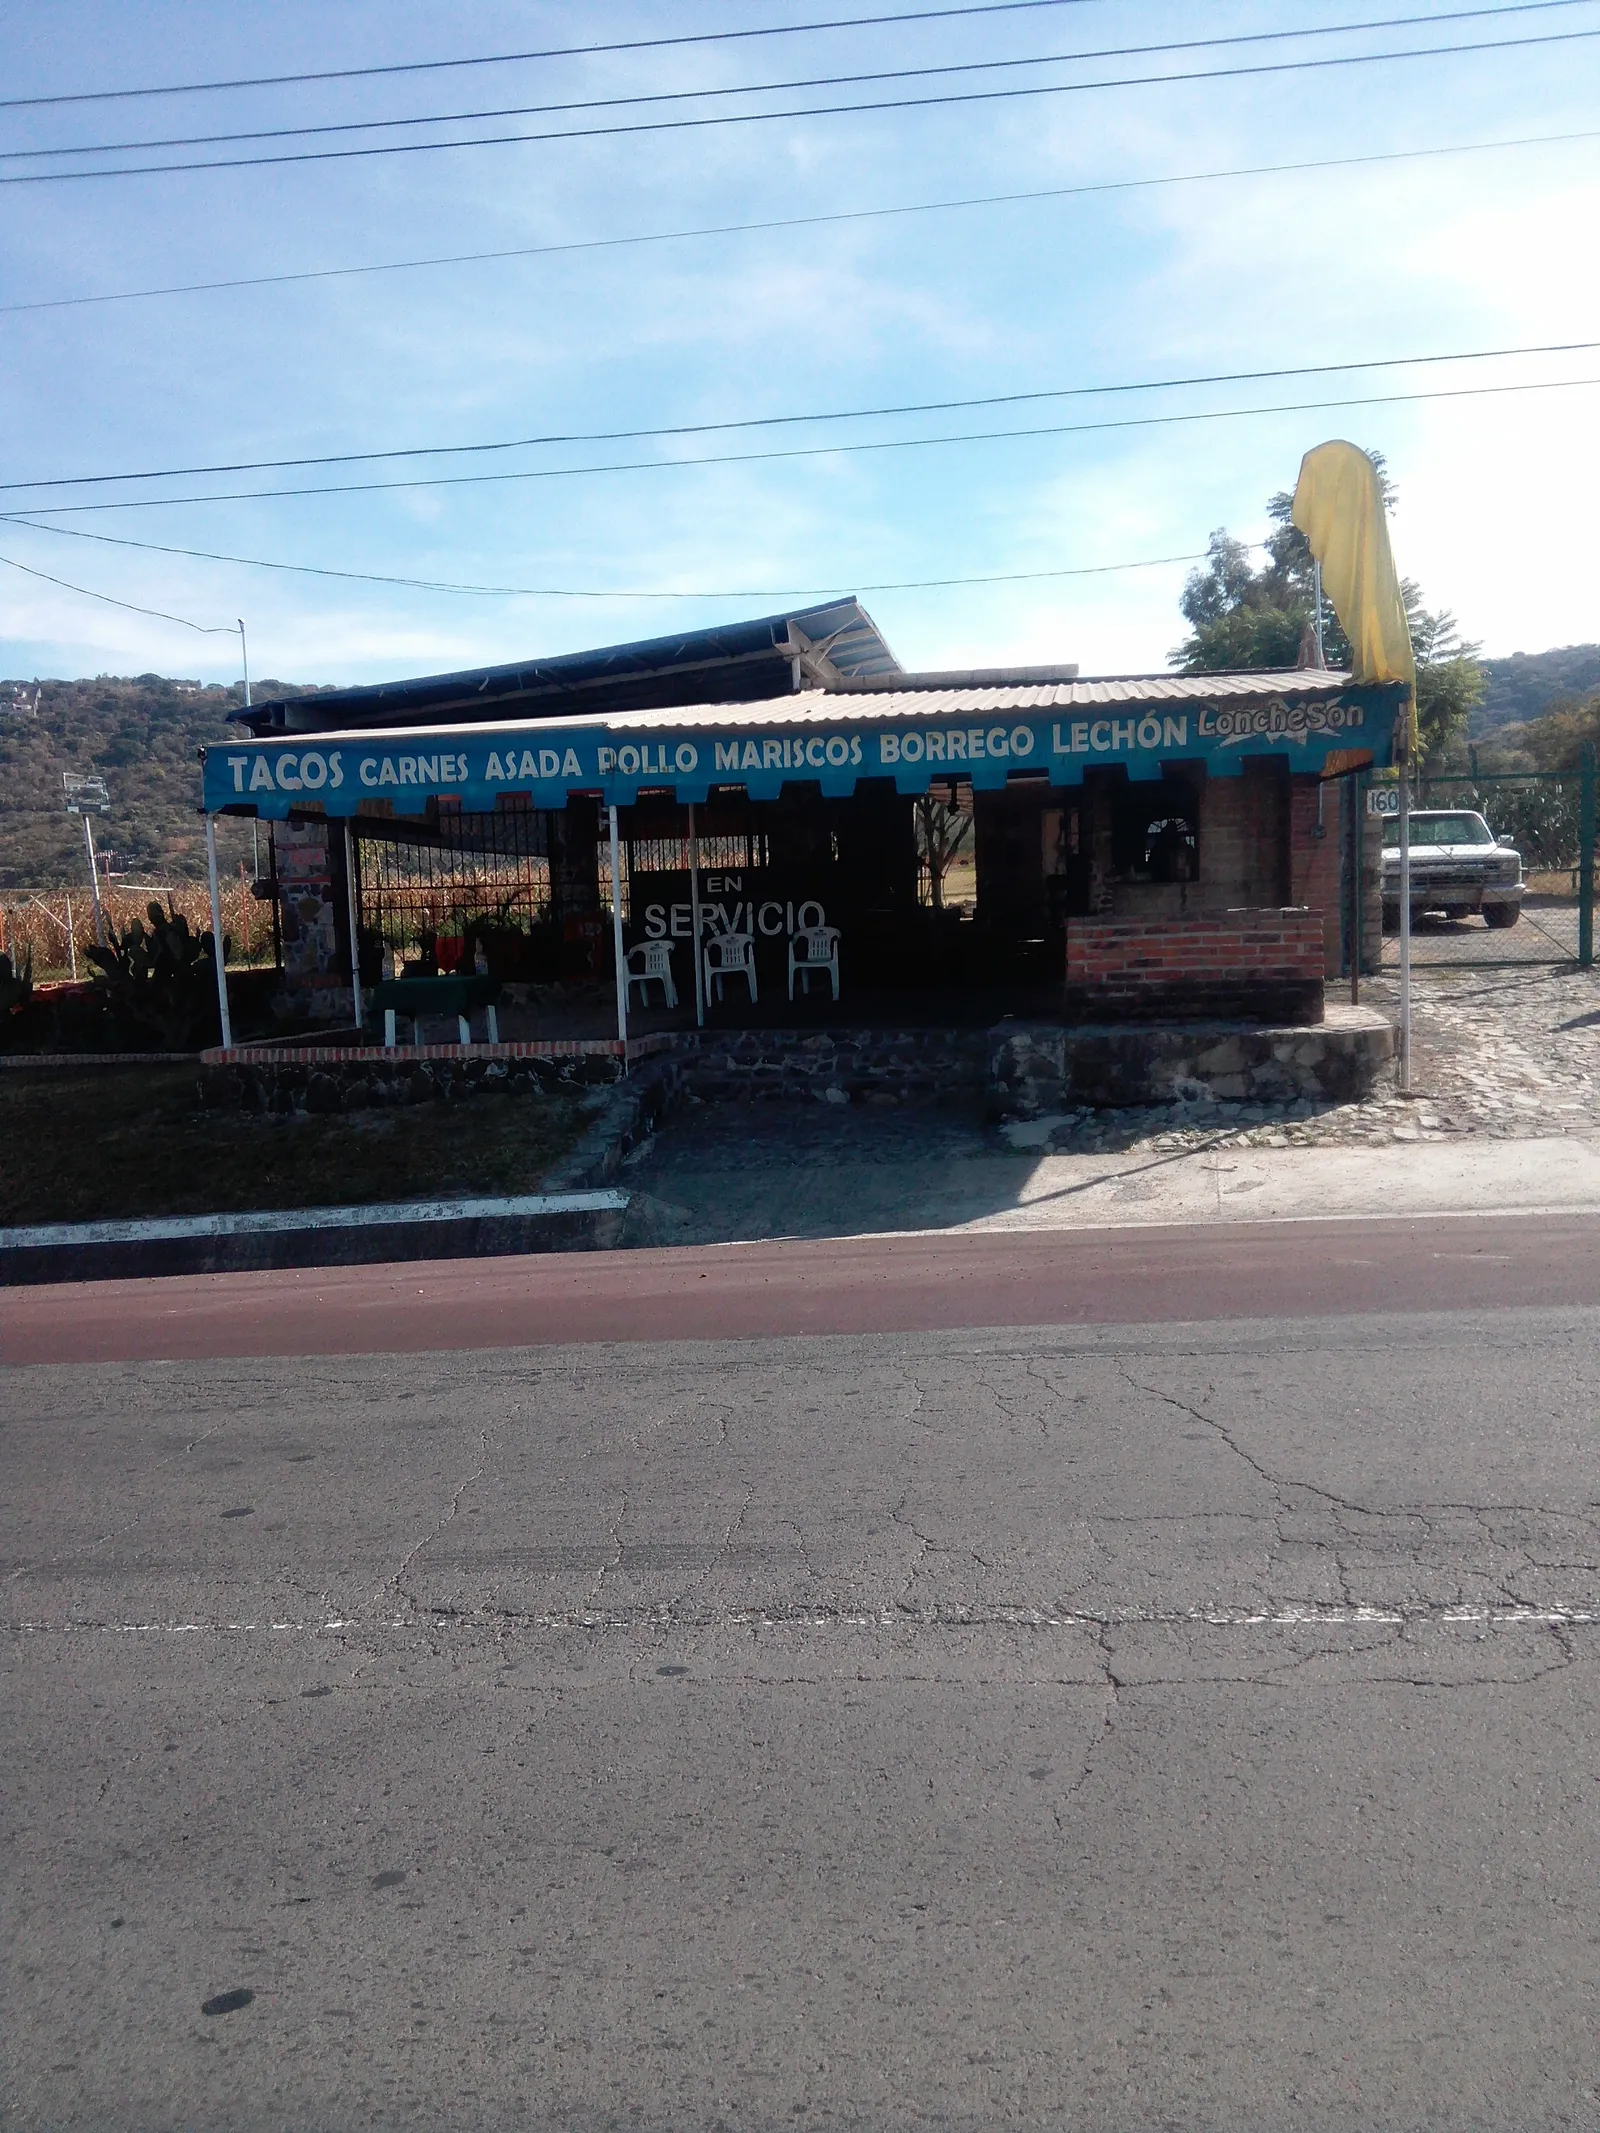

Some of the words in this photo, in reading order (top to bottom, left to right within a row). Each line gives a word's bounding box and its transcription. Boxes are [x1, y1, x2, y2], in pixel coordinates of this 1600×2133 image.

[227, 751, 344, 793] TACOS
[359, 753, 470, 787] CARNES
[485, 748, 583, 781] ASADA
[597, 743, 699, 776] POLLO
[714, 736, 862, 771] MARISCOS
[879, 725, 1035, 764] BORREGO
[1052, 709, 1188, 754] LECHÓN
[1371, 791, 1398, 812] 160
[706, 876, 743, 893] EN
[644, 900, 826, 938] SERVICIO
